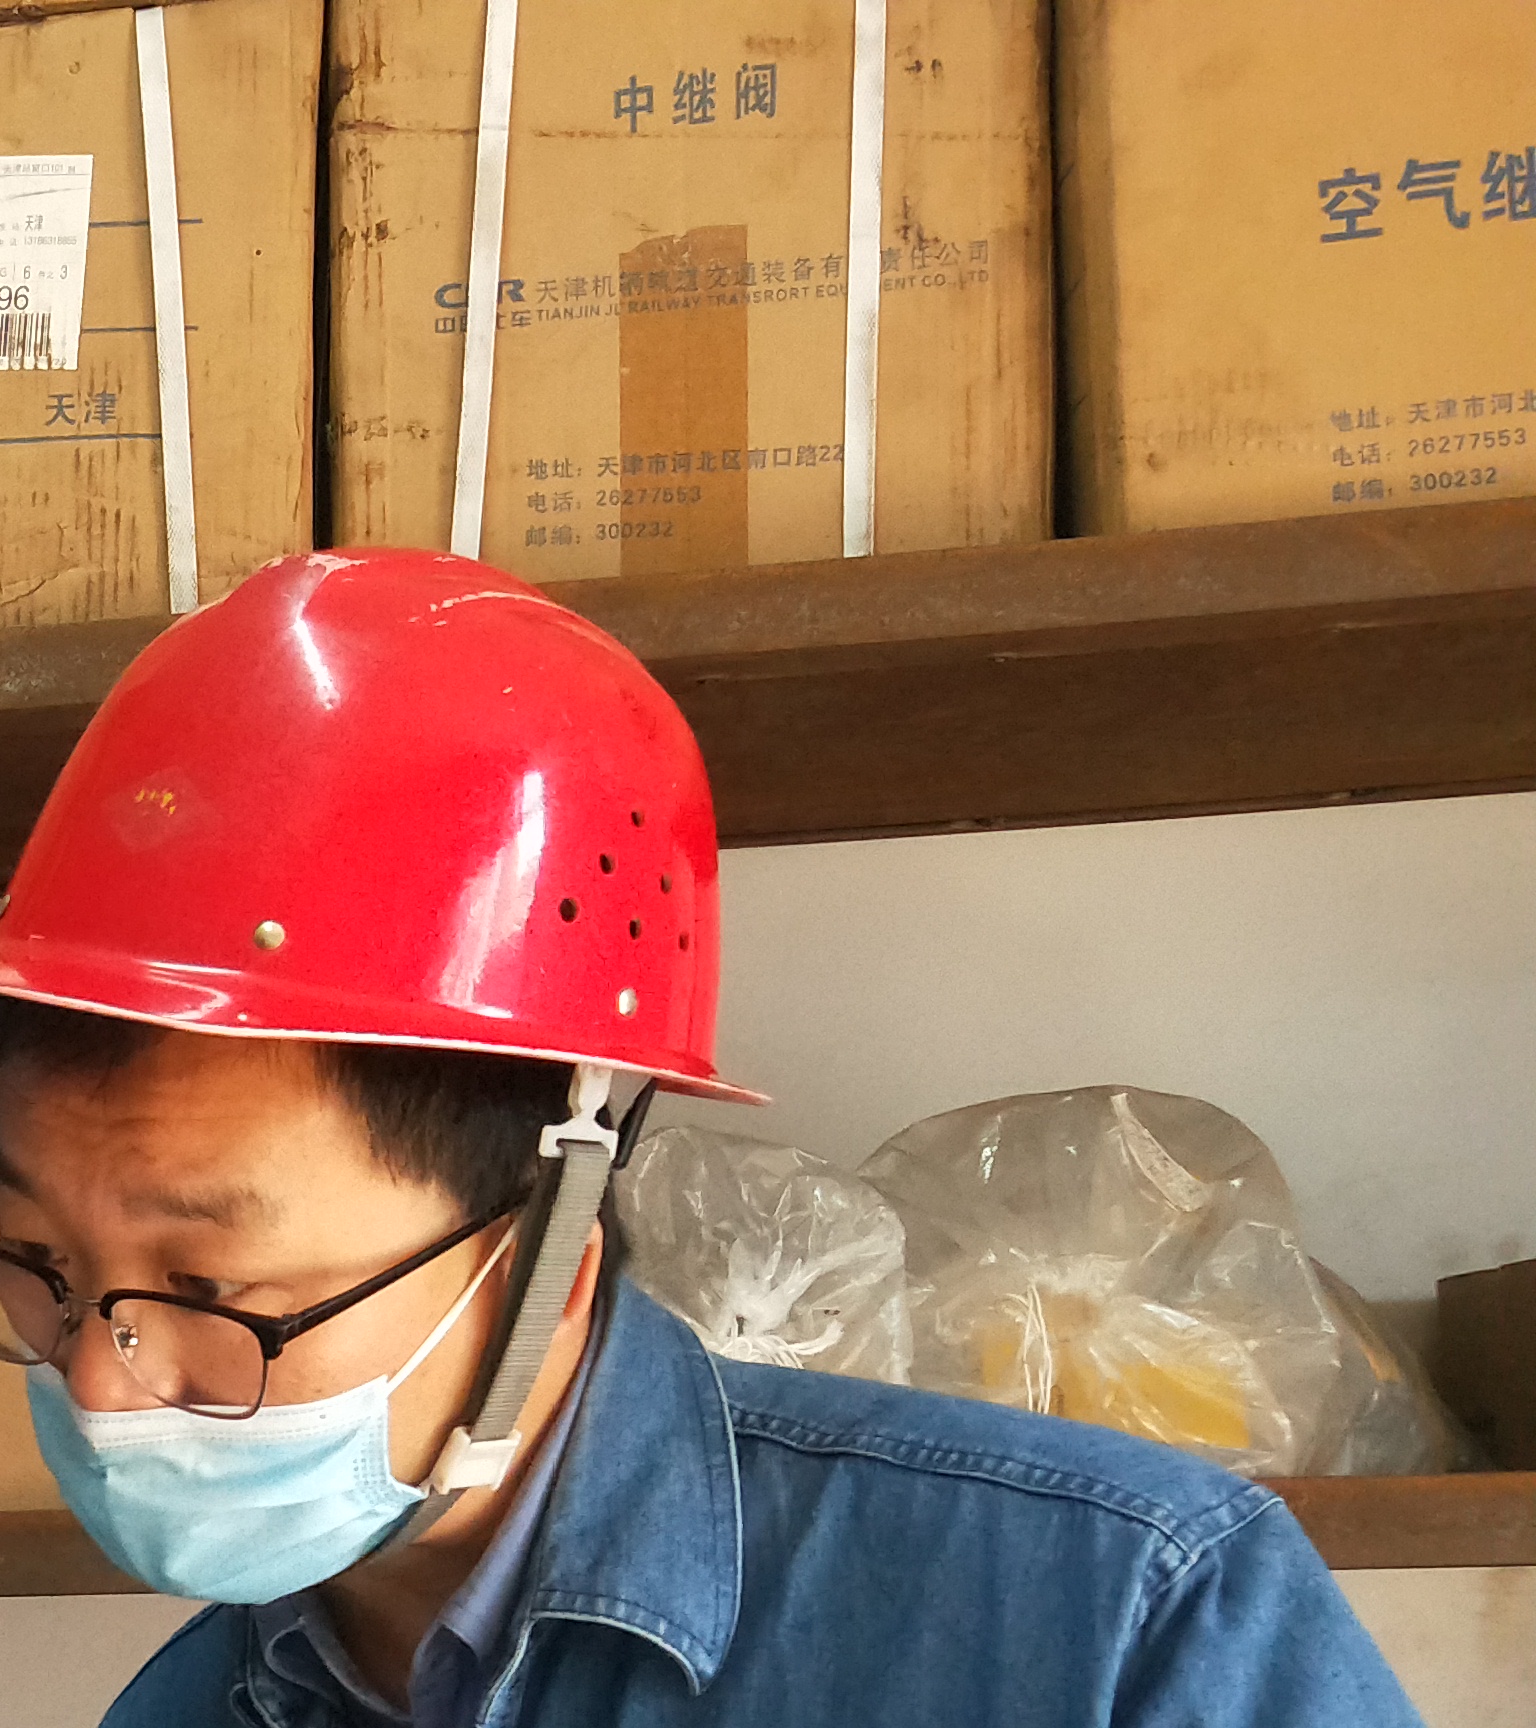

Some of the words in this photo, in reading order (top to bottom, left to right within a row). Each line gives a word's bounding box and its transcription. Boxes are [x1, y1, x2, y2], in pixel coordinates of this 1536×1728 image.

[613, 61, 778, 135] 中继阀
[1317, 146, 1536, 243] 空气继
[433, 278, 525, 310] CR
[44, 390, 118, 428] 天津
